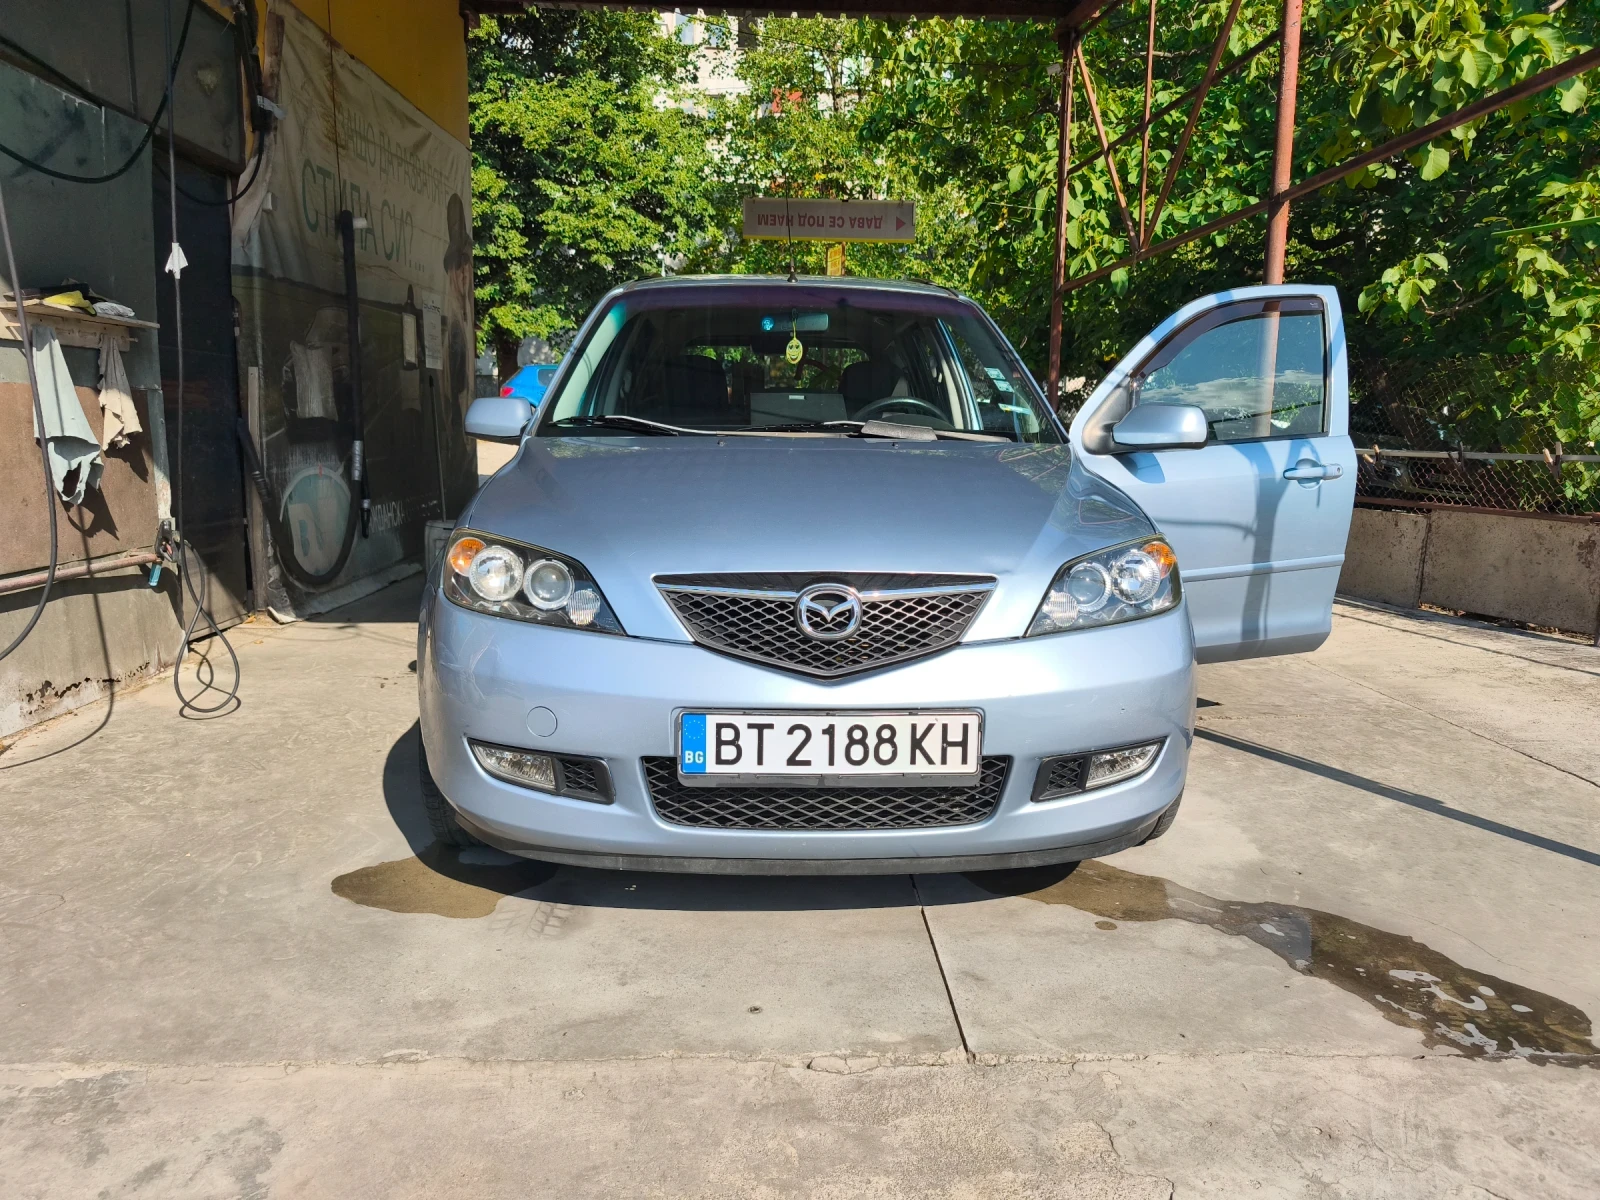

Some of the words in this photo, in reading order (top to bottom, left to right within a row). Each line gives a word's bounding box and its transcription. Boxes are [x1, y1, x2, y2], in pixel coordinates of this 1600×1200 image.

[379, 131, 400, 183] ДА
[757, 213, 793, 227] НАЕМ
[798, 213, 825, 227] ПОД
[829, 215, 845, 229] СЕ
[849, 216, 883, 229] ДАВА
[715, 722, 774, 766] BT
[786, 722, 898, 767] 2188
[909, 722, 969, 766] KH
[684, 750, 704, 764] BG
